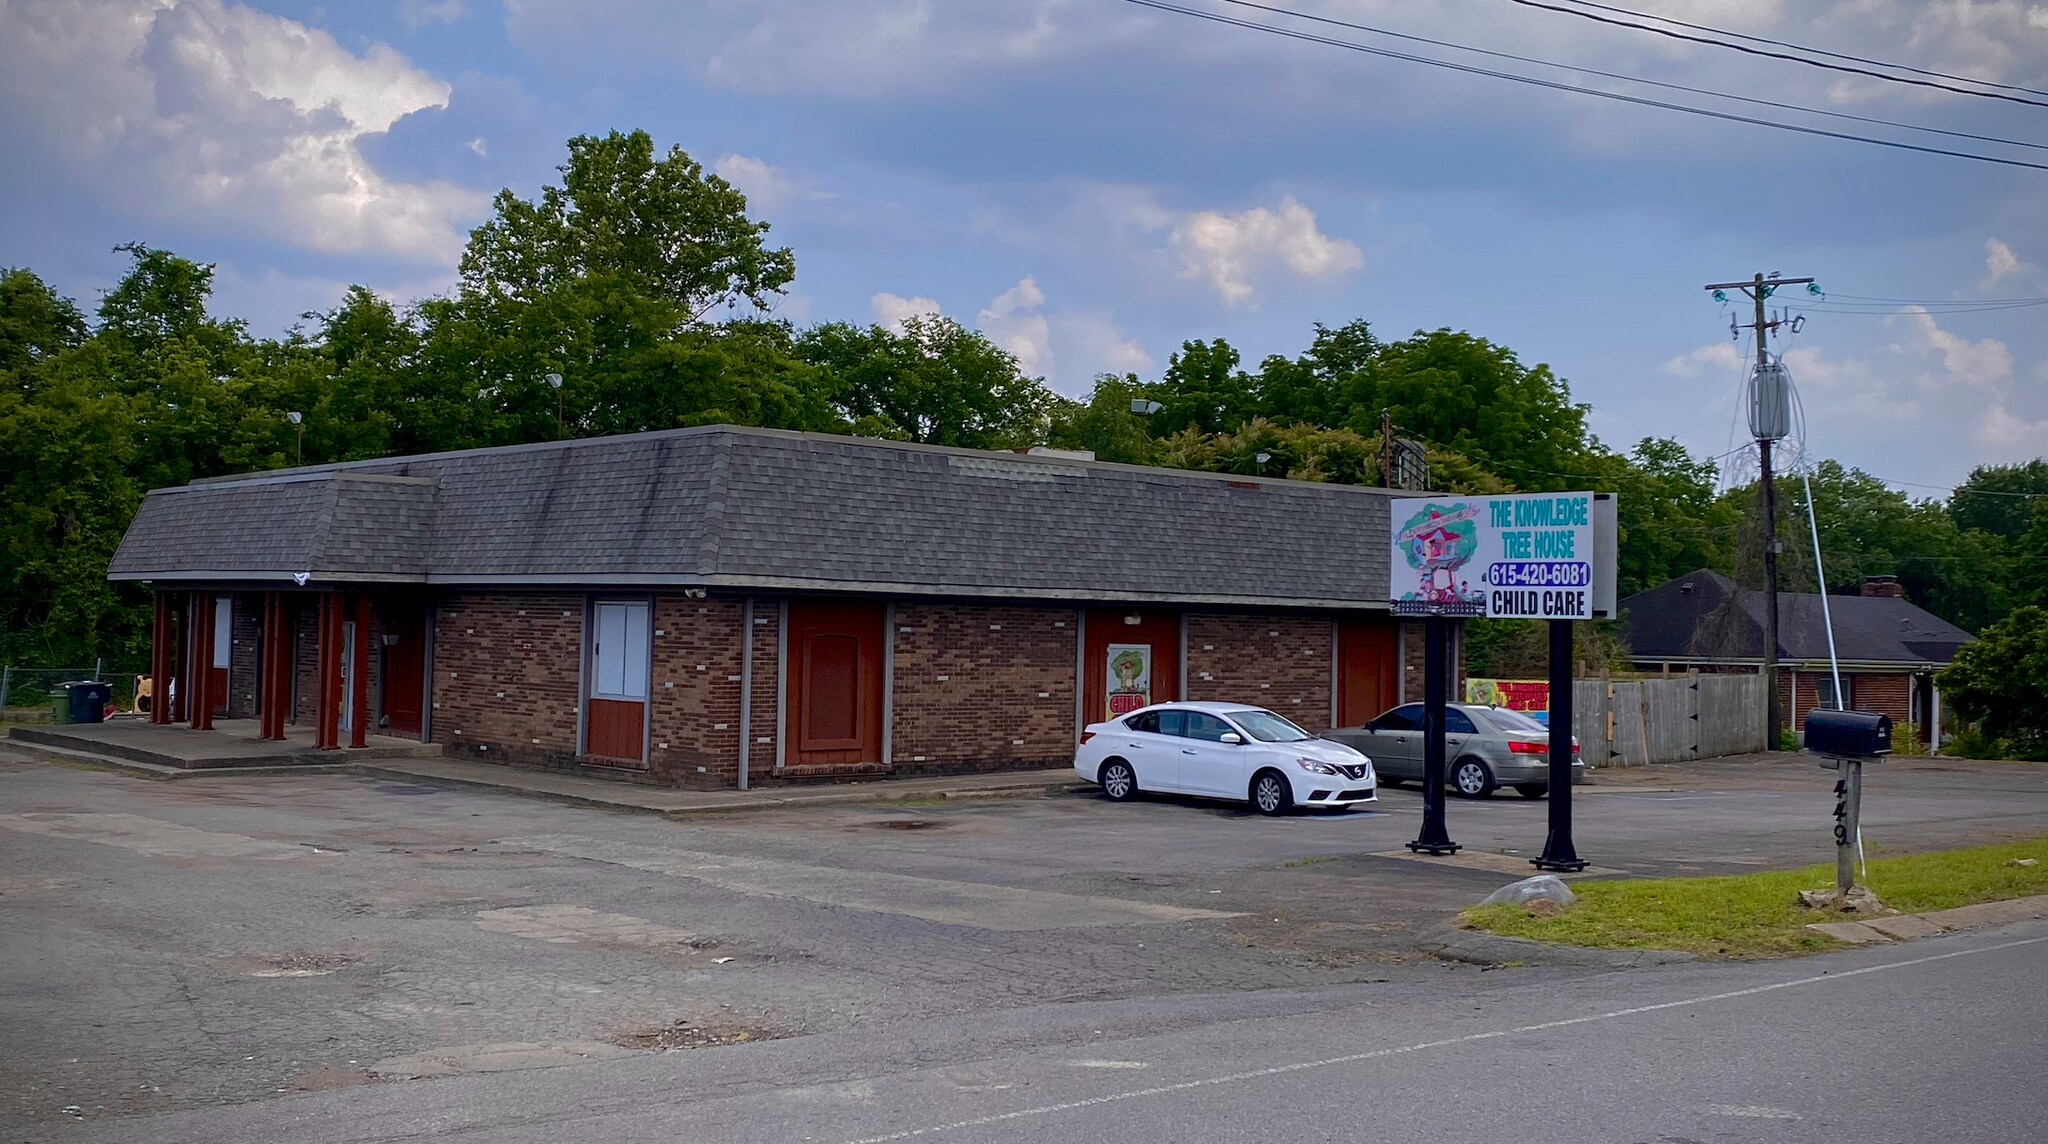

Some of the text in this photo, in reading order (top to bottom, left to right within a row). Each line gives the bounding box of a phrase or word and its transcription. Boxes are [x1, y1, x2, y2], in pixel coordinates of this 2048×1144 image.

[1489, 500, 1511, 528] THE
[1515, 497, 1588, 527] KNOWLEDGE
[1502, 530, 1575, 559] TREE HOUSE
[1490, 563, 1588, 585] 615-420-6081
[1492, 590, 1585, 616] CHILD CARE
[1110, 695, 1143, 713] CHILD
[1832, 779, 1847, 847] 449
